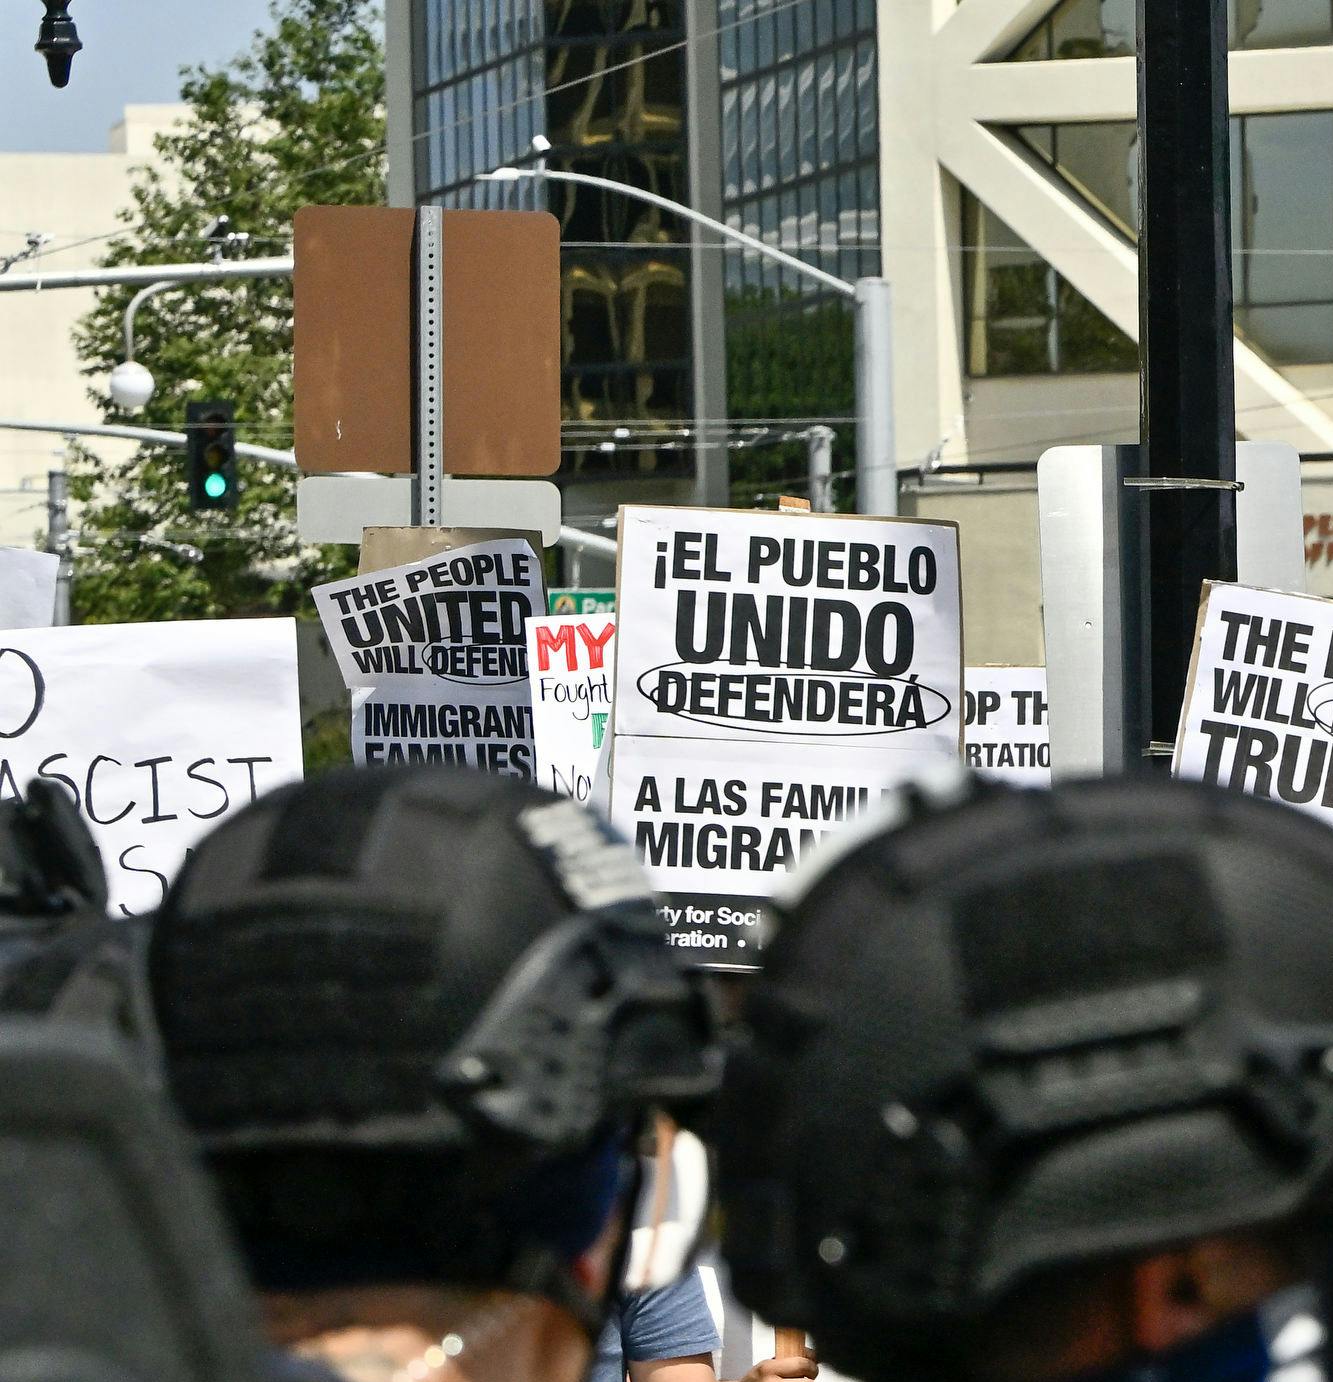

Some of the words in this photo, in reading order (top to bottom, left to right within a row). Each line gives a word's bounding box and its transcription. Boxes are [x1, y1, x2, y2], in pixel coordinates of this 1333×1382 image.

[329, 578, 400, 615] THE
[405, 553, 531, 593] PEOPLE
[654, 531, 731, 589] ¡EL
[747, 536, 937, 595] PUEBLO
[341, 590, 532, 649] UNITED
[535, 622, 616, 672] MY
[674, 590, 914, 680] UNIDO
[1220, 610, 1314, 674] THE
[351, 645, 423, 674] WILL
[431, 645, 529, 677] DEFEND
[539, 674, 612, 721] Fought
[657, 670, 927, 729] DEFENDERÁ
[1213, 667, 1316, 730] WILL
[634, 776, 661, 812] A
[674, 777, 748, 817] LAS
[685, 905, 714, 924] for
